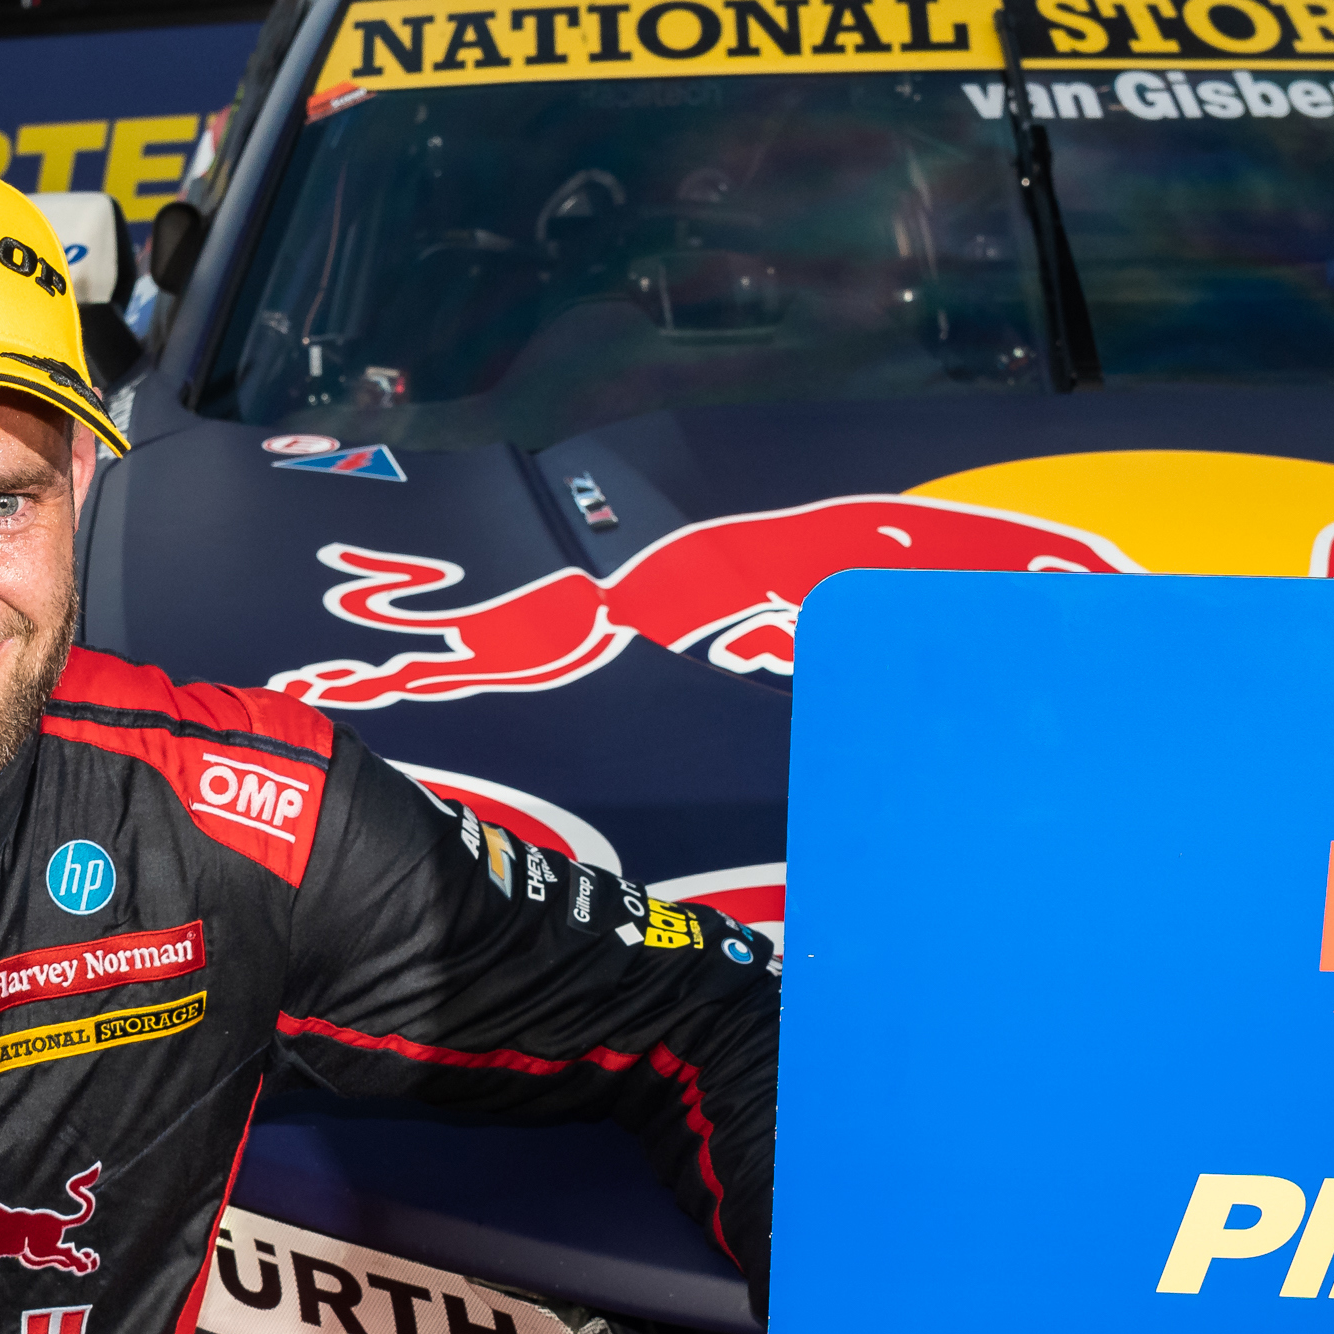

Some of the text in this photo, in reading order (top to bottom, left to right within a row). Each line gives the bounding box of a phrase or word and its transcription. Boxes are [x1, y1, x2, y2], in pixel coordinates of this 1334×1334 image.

[352, 0, 970, 78] NATIONAL
[963, 80, 1103, 120] van
[200, 765, 303, 826] OMP
[60, 843, 105, 911] hp
[573, 876, 594, 923] Giltrap
[86, 938, 195, 981] Norman
[100, 1002, 200, 1041] STORAGE
